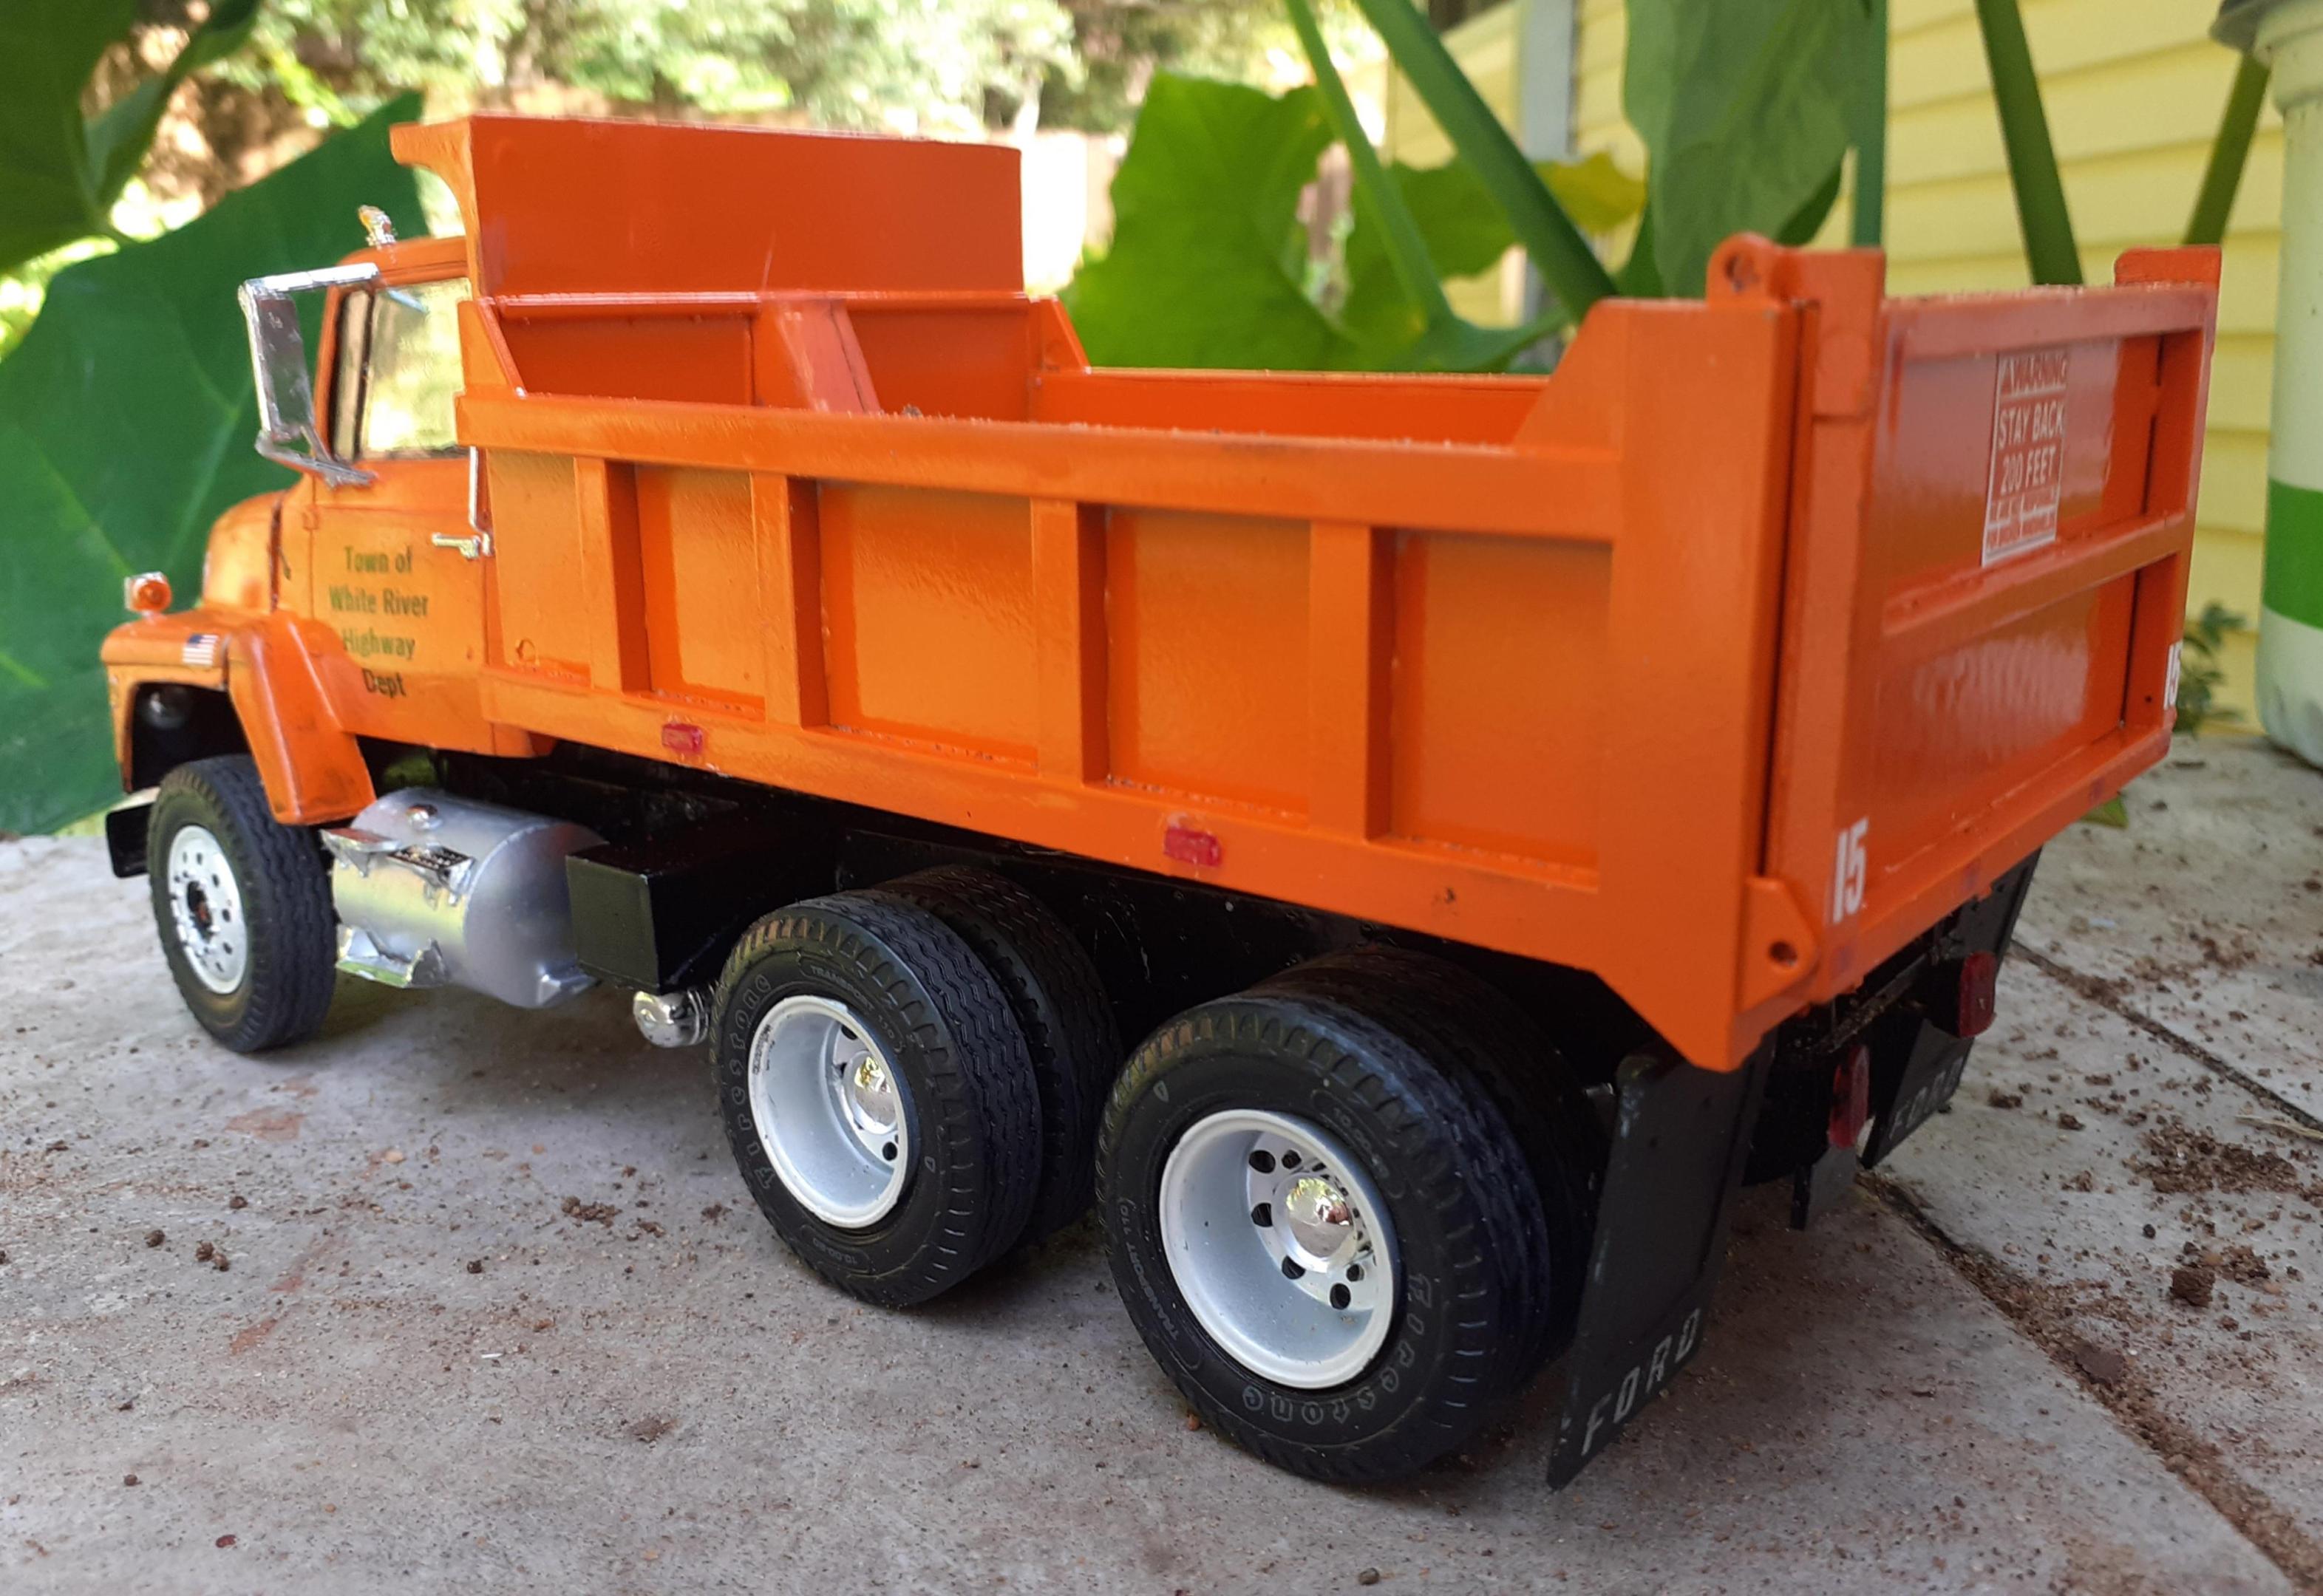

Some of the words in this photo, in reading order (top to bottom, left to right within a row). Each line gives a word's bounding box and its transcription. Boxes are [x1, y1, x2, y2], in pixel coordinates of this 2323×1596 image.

[1998, 406, 2030, 449] STAY
[2032, 399, 2064, 443] BACK
[2000, 452, 2024, 497] 200
[2025, 445, 2056, 488] FEET
[344, 546, 390, 573] Town
[395, 546, 412, 573] of
[329, 585, 377, 614] White
[383, 587, 429, 617] River
[342, 627, 415, 661] Highway
[362, 667, 407, 698] Dept
[1833, 816, 1869, 924] 15
[1581, 1307, 1701, 1456] FORD
